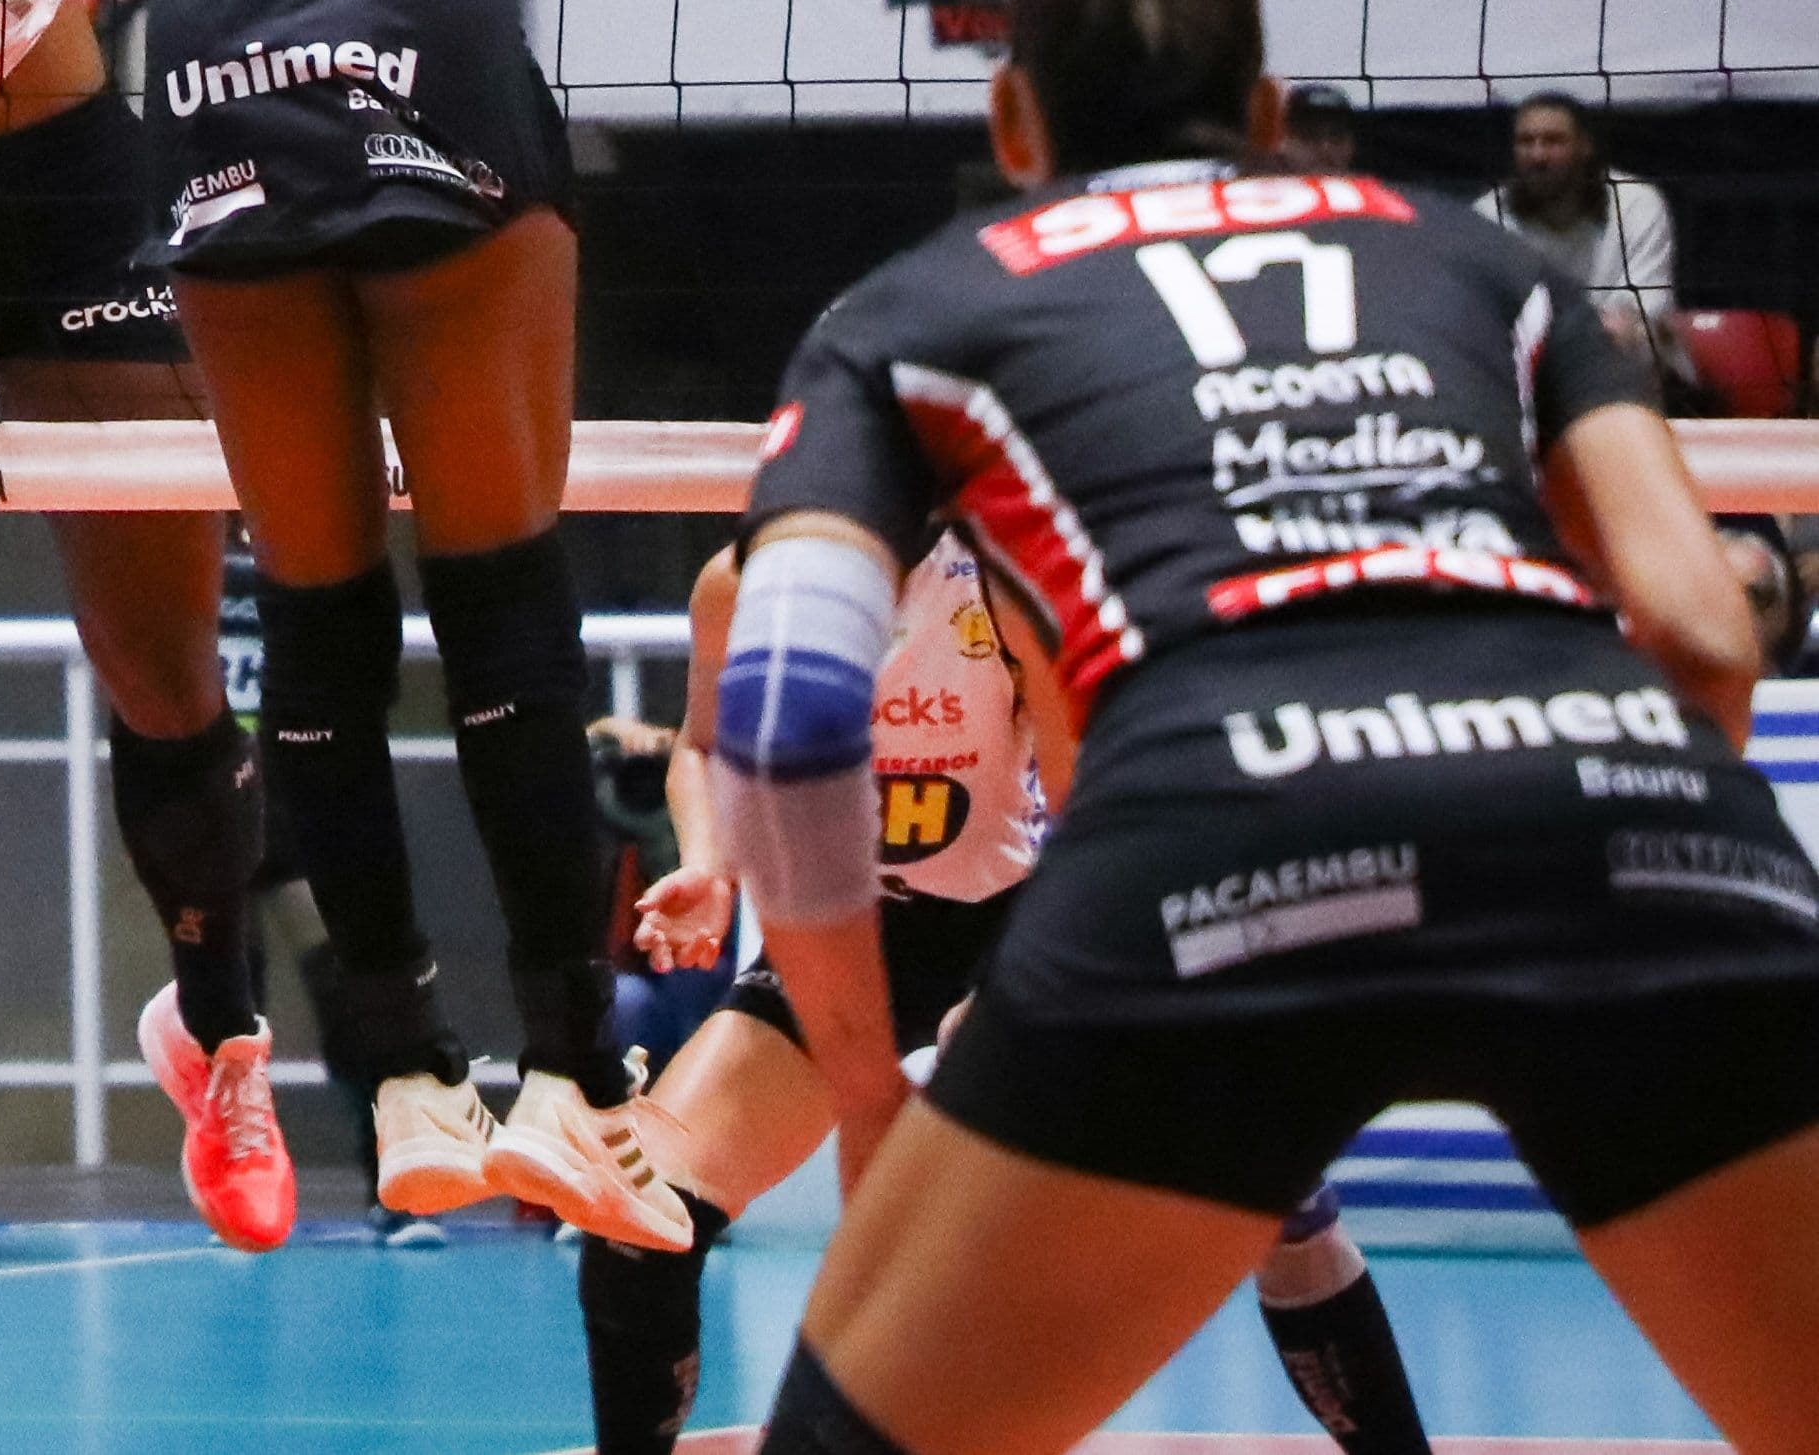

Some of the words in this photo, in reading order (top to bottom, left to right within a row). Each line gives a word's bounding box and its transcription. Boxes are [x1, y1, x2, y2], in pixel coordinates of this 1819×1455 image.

[166, 41, 418, 119] Unimed
[1030, 176, 1366, 256] SESI
[1136, 230, 1357, 370] 17
[1212, 411, 1486, 496] Medley
[1225, 686, 1688, 781] Unimed
[1577, 754, 1708, 803] Bauru
[1159, 844, 1419, 931] PACAEMBU
